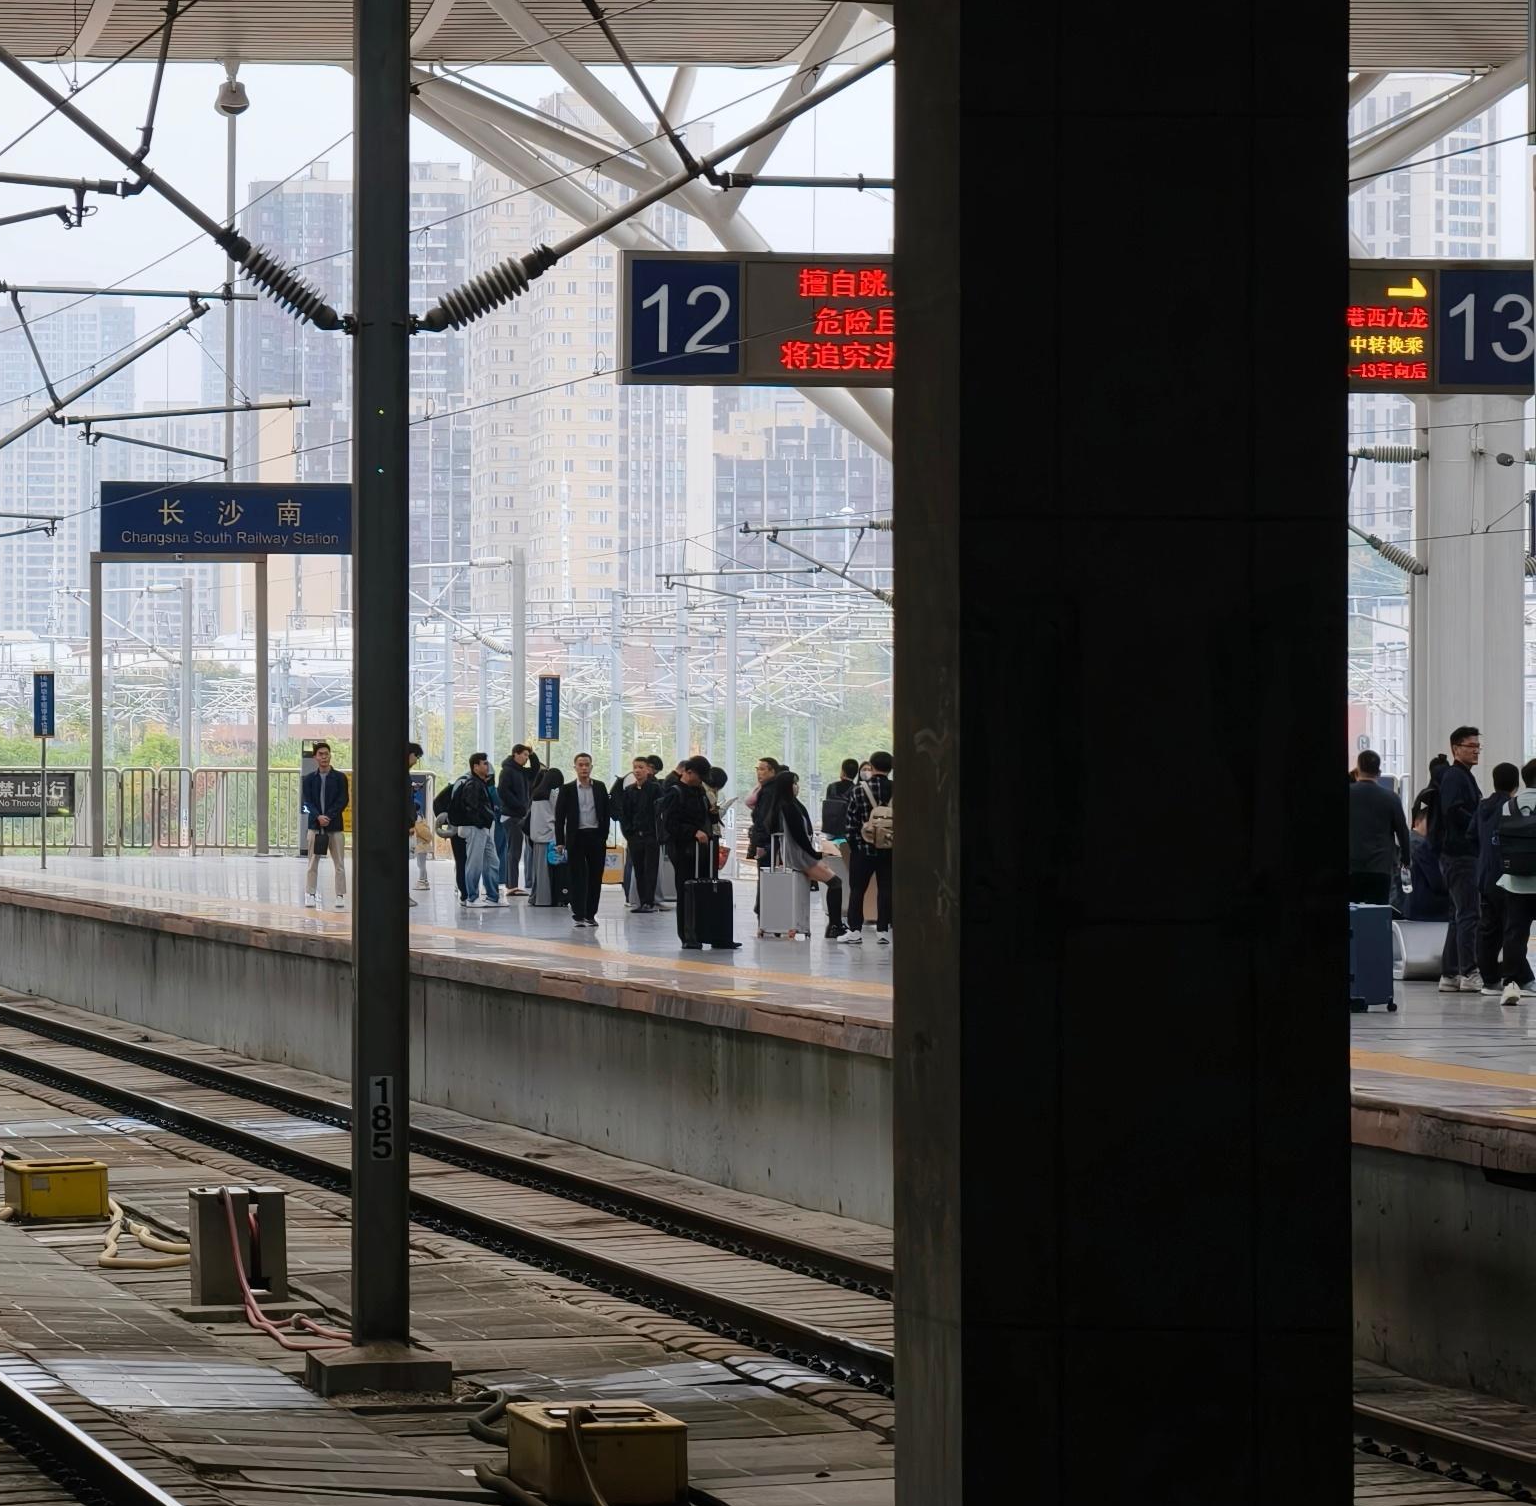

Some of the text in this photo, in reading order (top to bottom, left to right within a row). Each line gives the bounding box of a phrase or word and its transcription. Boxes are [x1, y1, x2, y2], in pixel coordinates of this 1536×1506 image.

[800, 268, 894, 297] 擅自跳
[642, 284, 731, 354] 12
[1449, 293, 1535, 363] 13
[1350, 336, 1424, 354] 中转换乘
[158, 498, 303, 527] 长沙南
[121, 531, 339, 547] Changsha South Railway Station
[371, 1077, 392, 1159] 185
